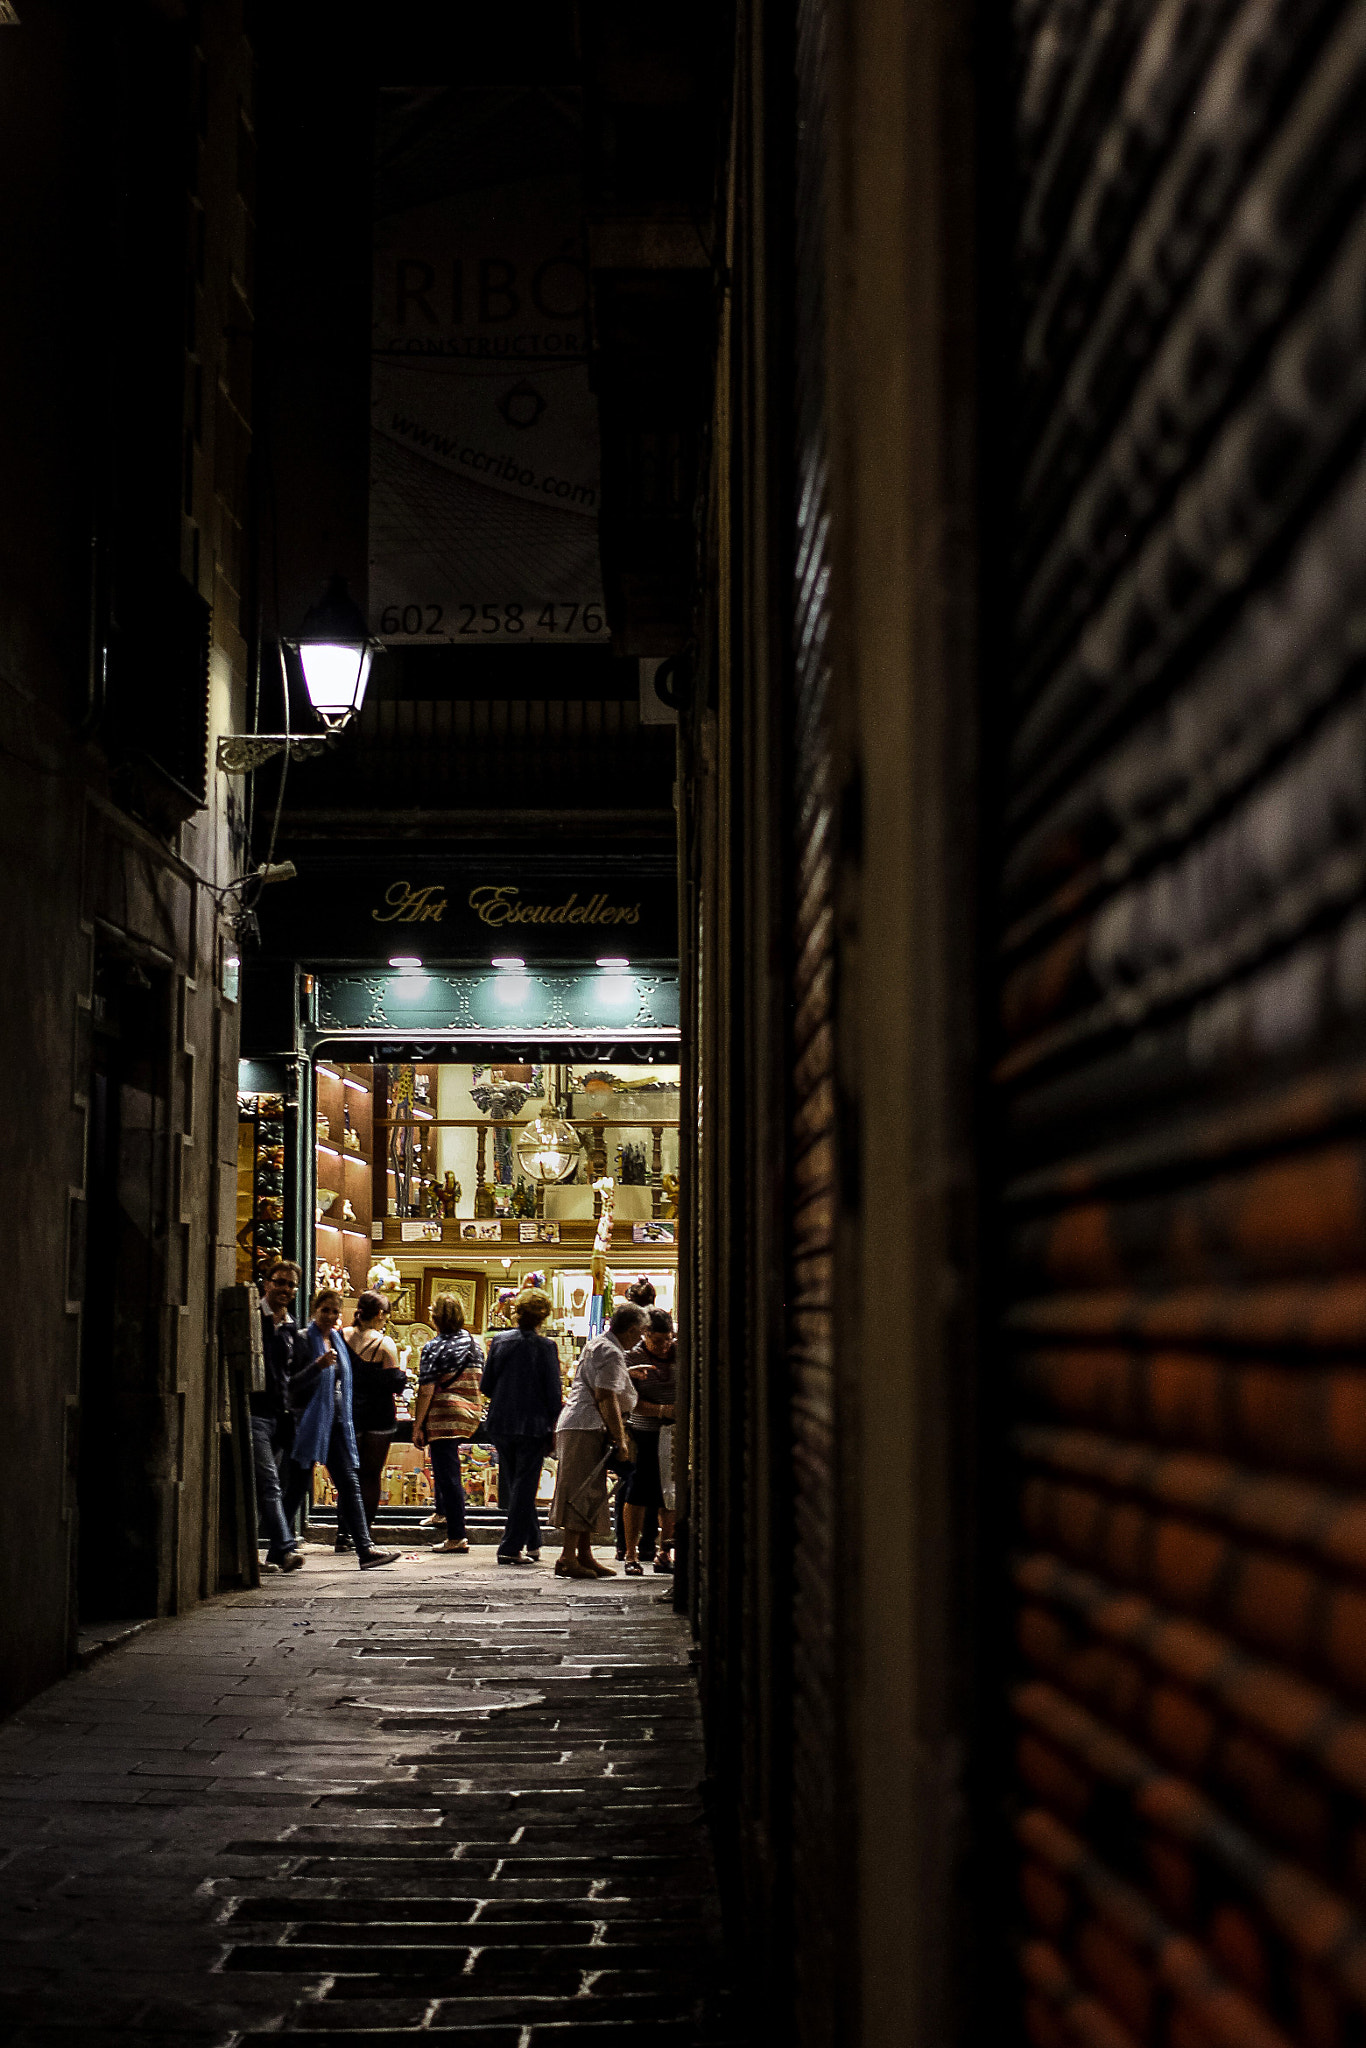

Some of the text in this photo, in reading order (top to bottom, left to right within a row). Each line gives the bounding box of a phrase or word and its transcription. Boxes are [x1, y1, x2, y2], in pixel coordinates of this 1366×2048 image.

[391, 412, 597, 505] www.ccribo.com
[380, 601, 602, 635] 602 258 476
[371, 880, 643, 927] Art Escudellers
